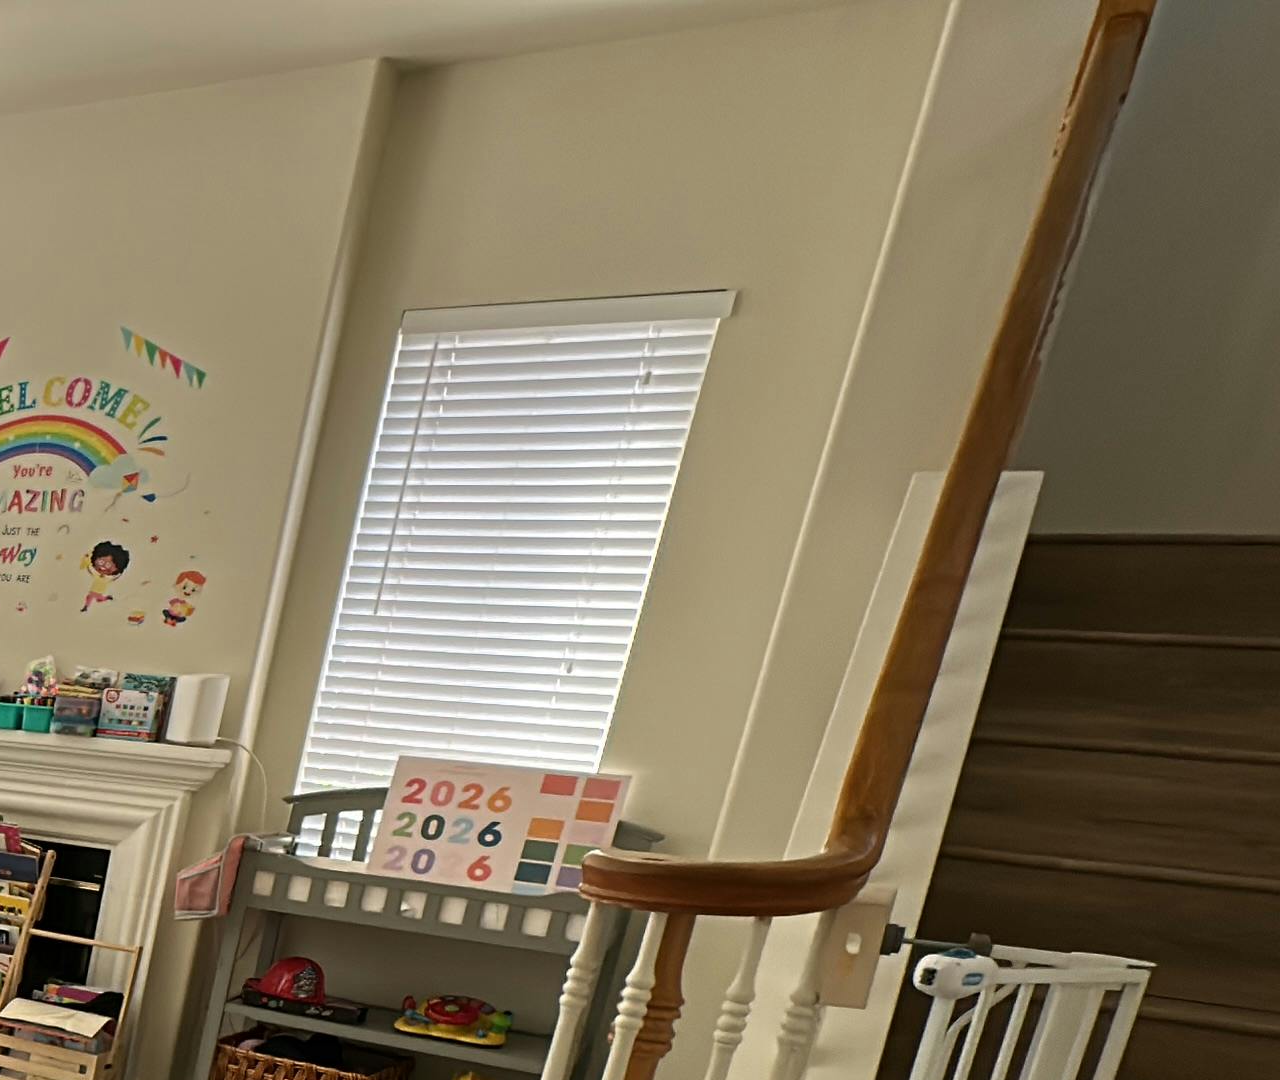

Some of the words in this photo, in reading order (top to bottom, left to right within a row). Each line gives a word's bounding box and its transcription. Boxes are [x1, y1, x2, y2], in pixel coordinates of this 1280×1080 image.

[13, 463, 54, 479] You're
[2, 524, 21, 536] JUST
[26, 527, 41, 537] THE
[0, 543, 38, 567] Way
[16, 574, 32, 584] ARE
[401, 777, 513, 814] 2026
[391, 811, 503, 848] 2026
